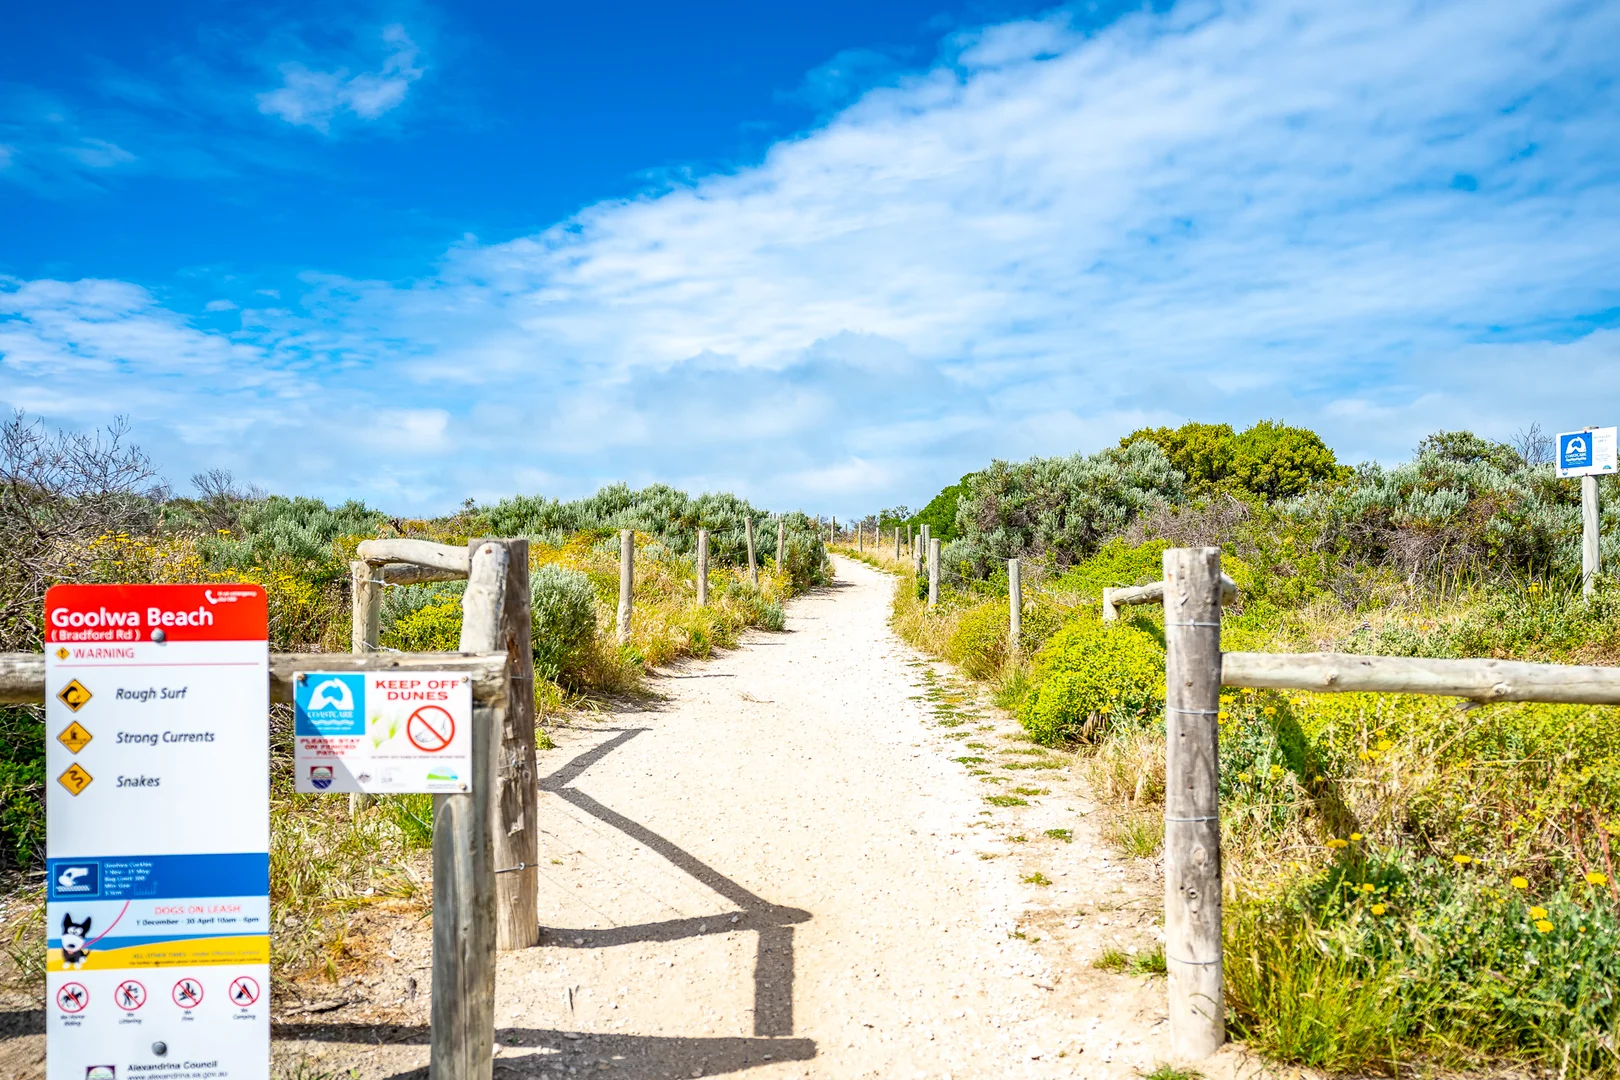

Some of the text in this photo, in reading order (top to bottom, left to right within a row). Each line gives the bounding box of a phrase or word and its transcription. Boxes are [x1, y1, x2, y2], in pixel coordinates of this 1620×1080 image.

[51, 606, 213, 627] Goolwa Beach
[73, 648, 135, 659] WARNING
[375, 680, 460, 690] KEEP OFF
[115, 686, 188, 703] Rough Surf
[387, 691, 449, 701] DUNES
[115, 731, 215, 746] Strong Currents
[115, 774, 161, 787] Snakes
[154, 904, 241, 915] DOGS ON LEASH
[127, 1060, 218, 1072] Alexandrina Council
